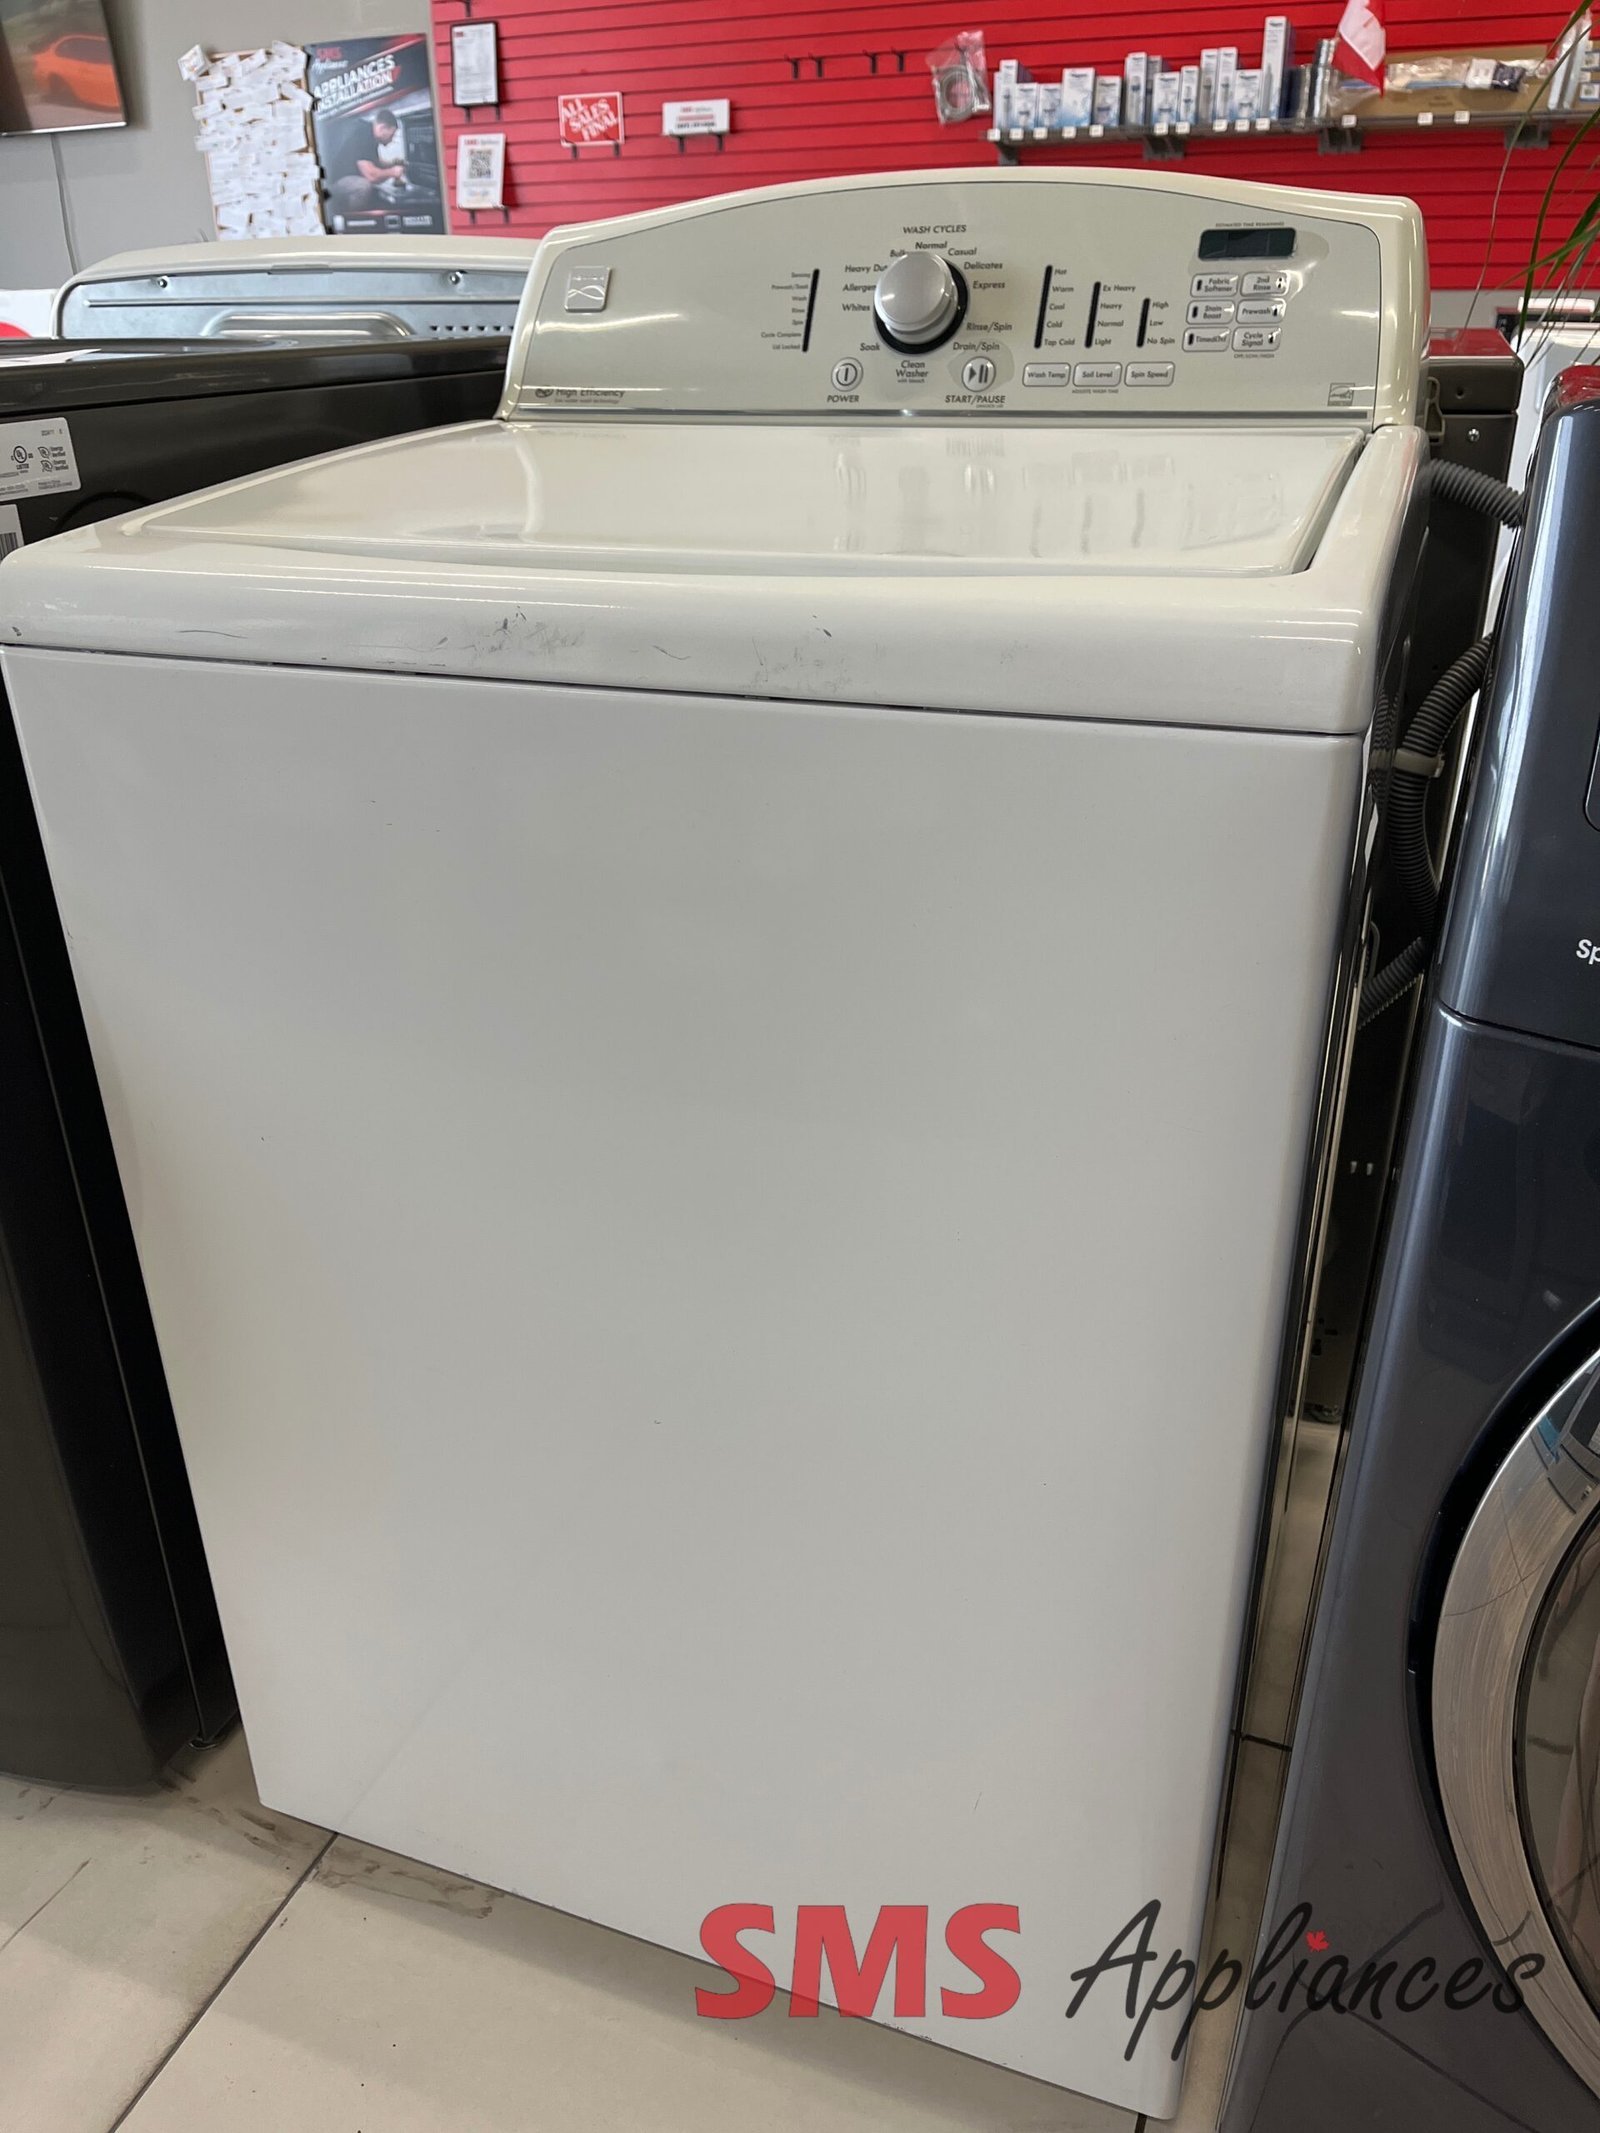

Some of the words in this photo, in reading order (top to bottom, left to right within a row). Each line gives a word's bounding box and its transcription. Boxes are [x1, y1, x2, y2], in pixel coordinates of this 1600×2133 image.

[313, 54, 396, 98] APPLIANCES
[902, 226, 931, 234] WASH
[933, 224, 967, 233] CYCLES
[914, 240, 948, 250] Normal
[947, 247, 978, 256] Casual
[844, 264, 871, 274] Heavy
[963, 261, 1003, 270] Delicates
[1054, 268, 1067, 276] Hot
[972, 280, 1006, 290] Express
[1102, 284, 1111, 292] Ex
[1113, 284, 1136, 293] Heavy
[1204, 285, 1233, 293] Softener
[1253, 283, 1272, 291] Rinse
[841, 303, 870, 311] Whites
[1049, 303, 1066, 311] Cool
[1151, 301, 1169, 310] High
[1241, 307, 1271, 315] Prewash
[966, 321, 1013, 333] Rinse/Spin
[1046, 320, 1063, 328] Cold
[1243, 331, 1264, 339] Cycle
[1043, 338, 1057, 346] Tap
[1058, 338, 1076, 346] Cold
[1094, 338, 1112, 346] Light
[1147, 337, 1158, 345] No
[1159, 337, 1176, 345] Spin
[1241, 338, 1264, 348] Signal
[859, 342, 880, 351] Soak
[952, 341, 1000, 352] Drain/Spin
[900, 360, 926, 369] Clean
[895, 368, 929, 378] Washer
[1082, 370, 1095, 378] Soil
[1095, 370, 1113, 378] Level
[1131, 370, 1145, 379] Spin
[1146, 370, 1169, 379] Speed
[826, 394, 860, 403] POWER
[945, 394, 1006, 405] START/PAUSE
[1575, 938, 1600, 965] Sp
